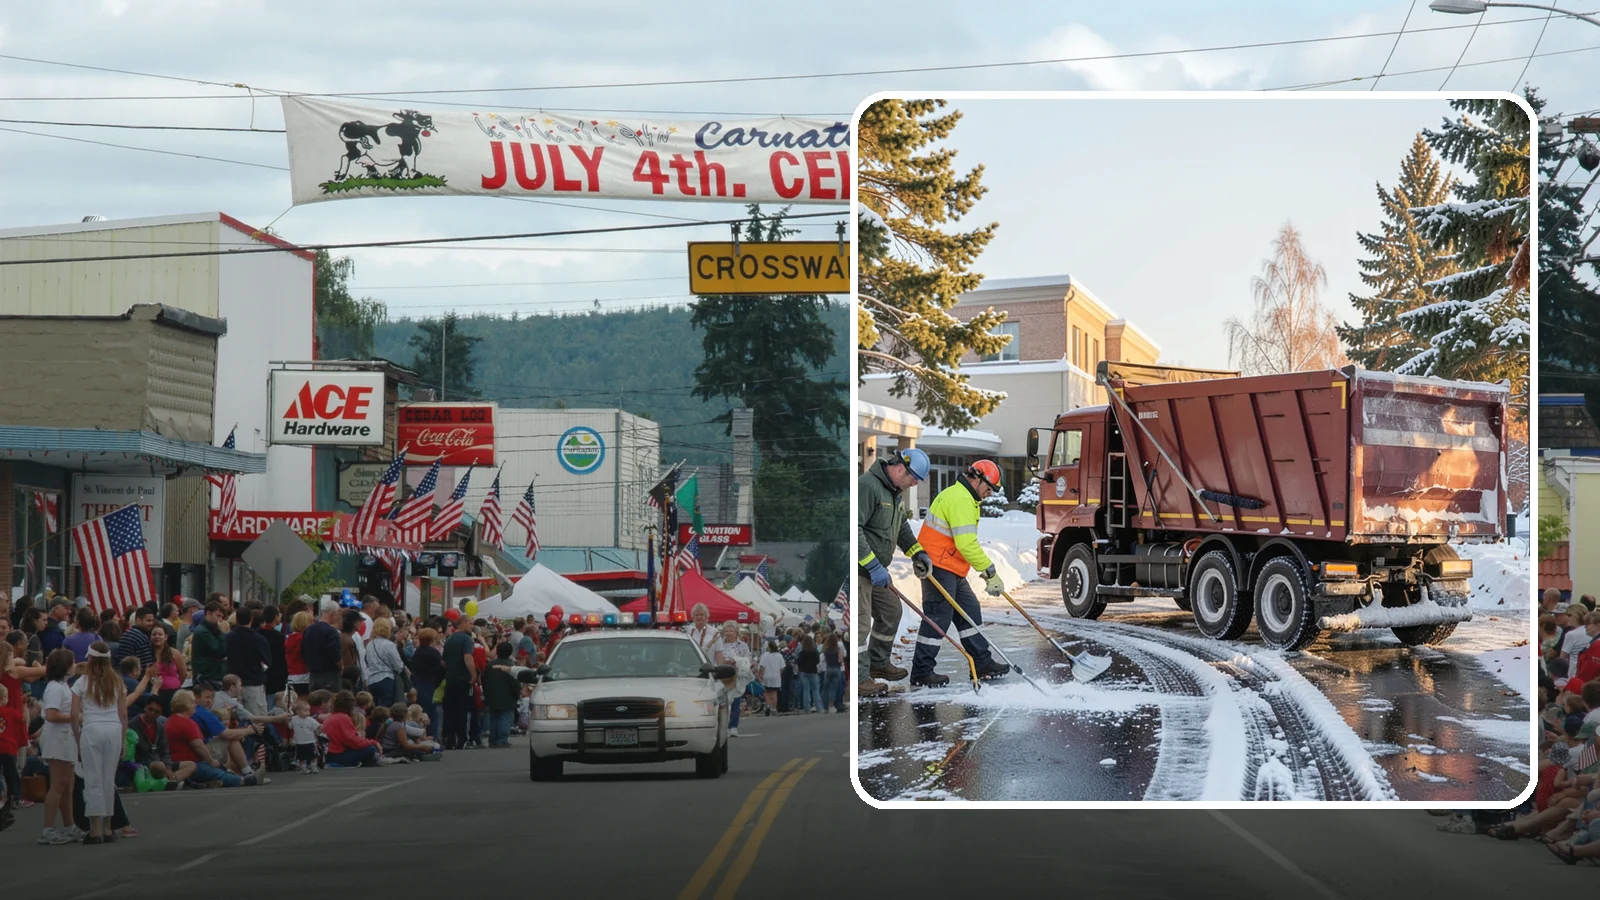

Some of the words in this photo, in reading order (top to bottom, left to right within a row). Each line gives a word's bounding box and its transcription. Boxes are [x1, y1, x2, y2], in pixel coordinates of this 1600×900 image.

[695, 121, 850, 150] Carnat
[481, 141, 604, 193] JULY
[632, 149, 746, 198] 4th.
[697, 253, 850, 280] CROSSWA
[282, 380, 373, 420] ACE
[405, 409, 453, 422] CEDAR
[461, 409, 485, 422] LOG
[283, 421, 371, 437] Hardware
[416, 428, 477, 447] Coca-Cola
[353, 467, 386, 481] Simpl
[96, 485, 124, 495] Vincent
[126, 486, 136, 495] de
[138, 486, 155, 495] Paul
[688, 526, 741, 535] CRNATION
[699, 535, 730, 543] GLASS
